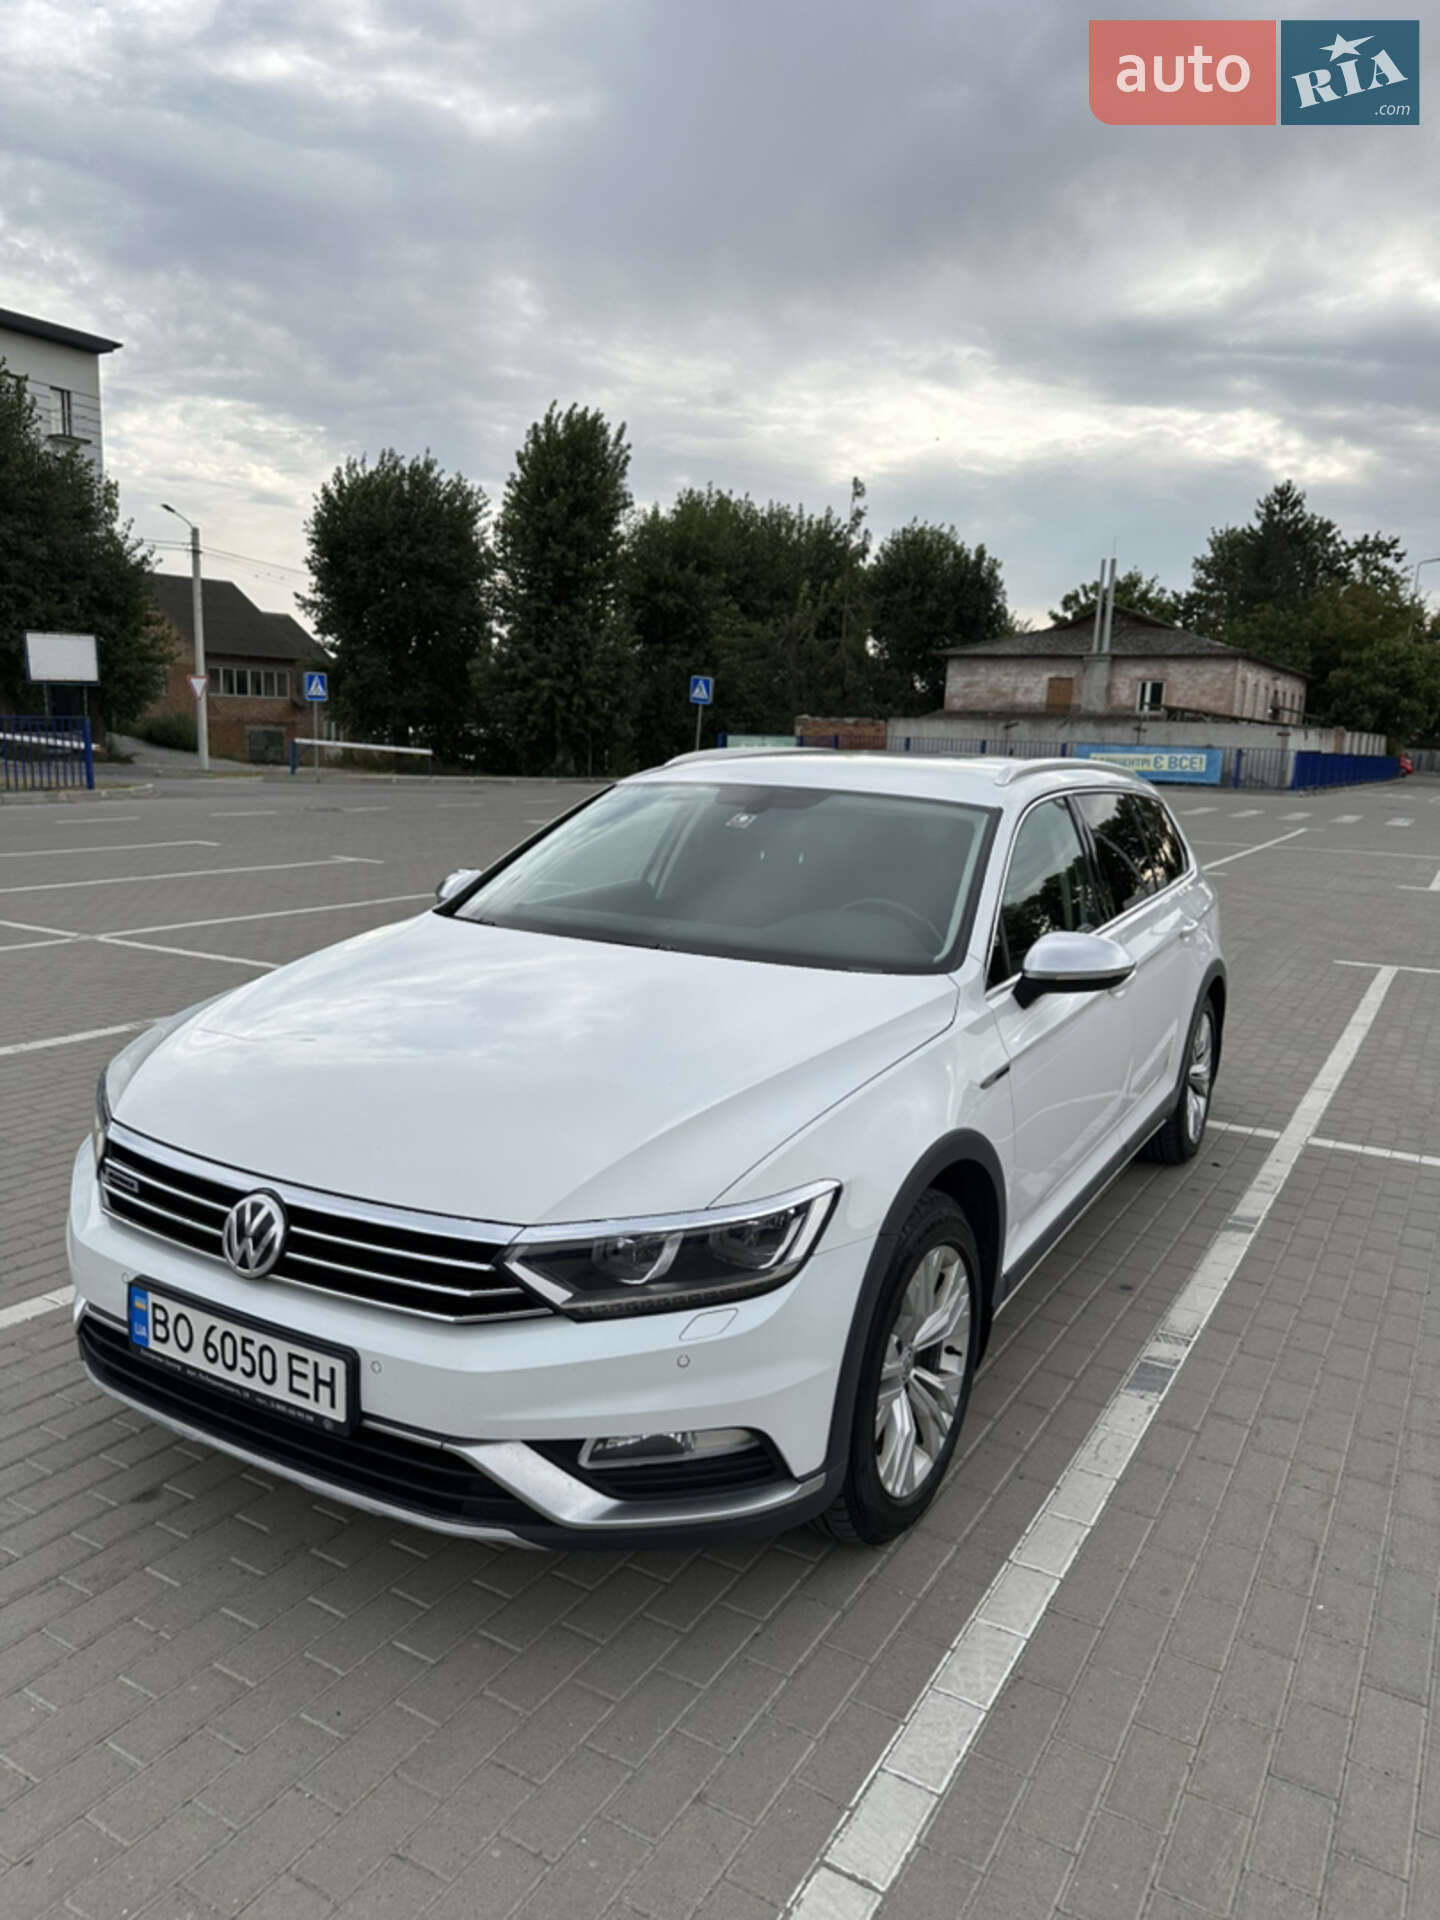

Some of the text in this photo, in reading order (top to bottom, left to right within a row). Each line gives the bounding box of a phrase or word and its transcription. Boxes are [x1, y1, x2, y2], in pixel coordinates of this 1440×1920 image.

[151, 1301, 194, 1354] BO
[203, 1324, 277, 1386] 6050
[287, 1350, 336, 1410] EH
